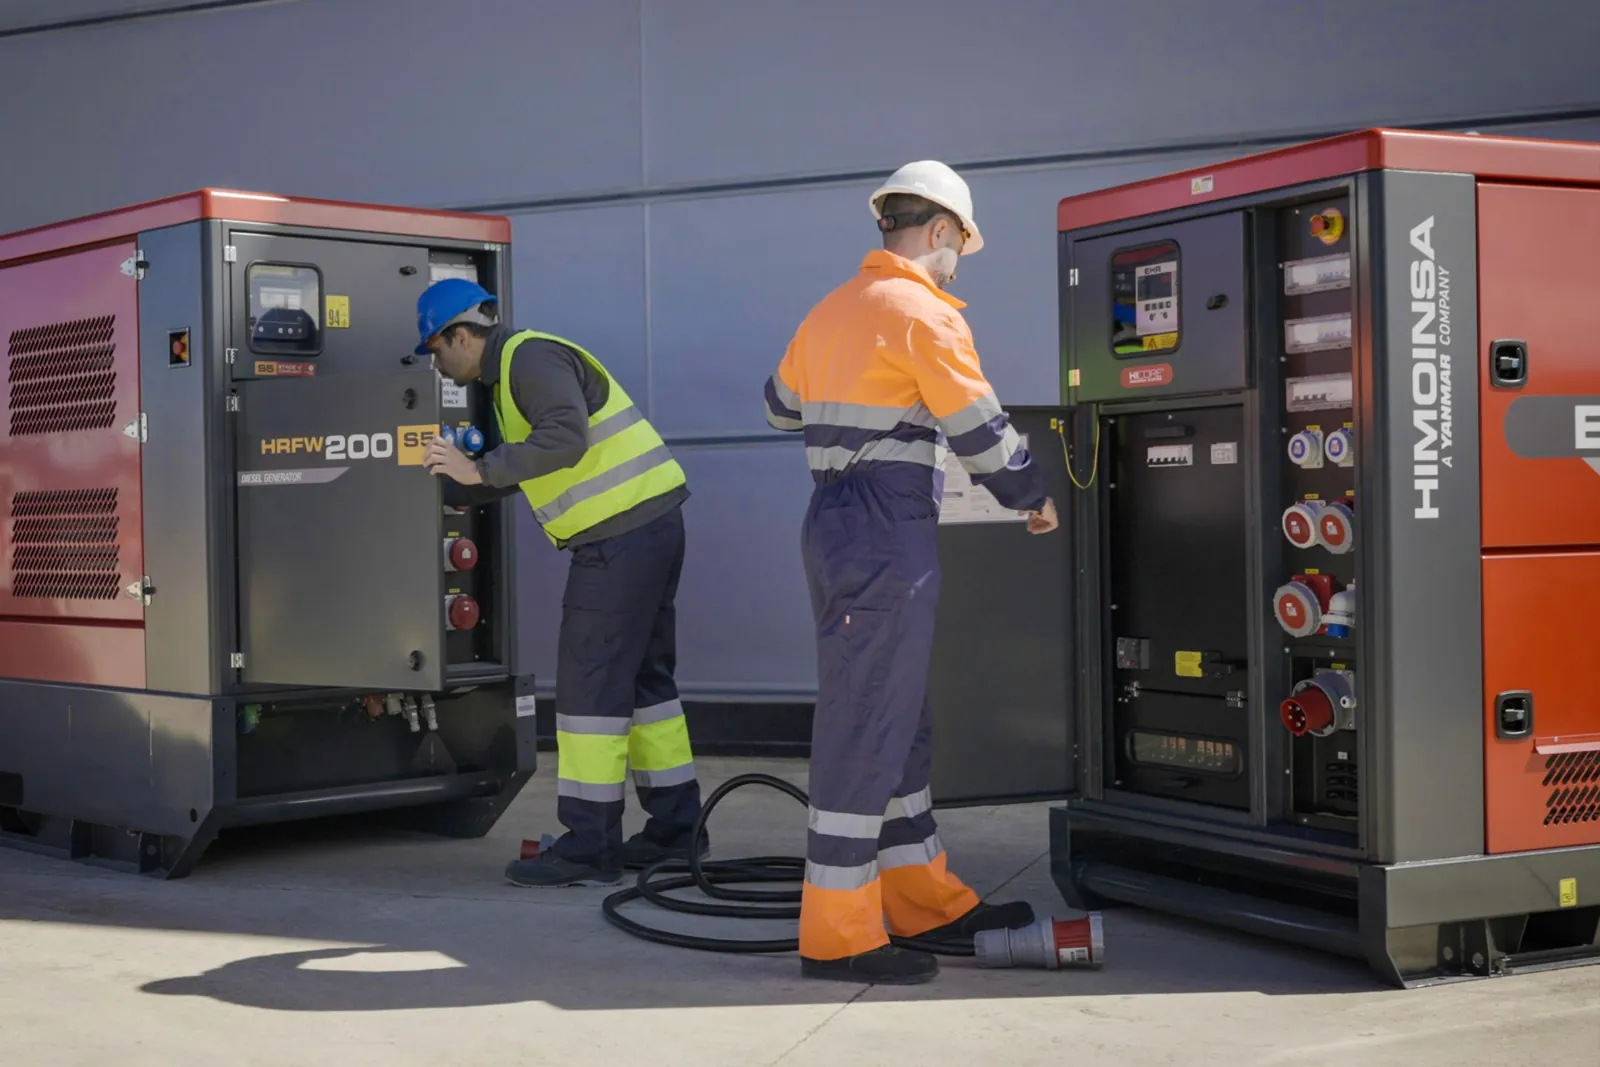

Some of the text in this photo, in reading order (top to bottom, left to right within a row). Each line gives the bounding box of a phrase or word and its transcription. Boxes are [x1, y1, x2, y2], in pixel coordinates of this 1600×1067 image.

[1410, 215, 1439, 519] HIMOINSA
[1438, 265, 1452, 468] A YANMAR COMPANY
[241, 472, 302, 483] DIESEL GENERATOR
[403, 431, 434, 448] S5
